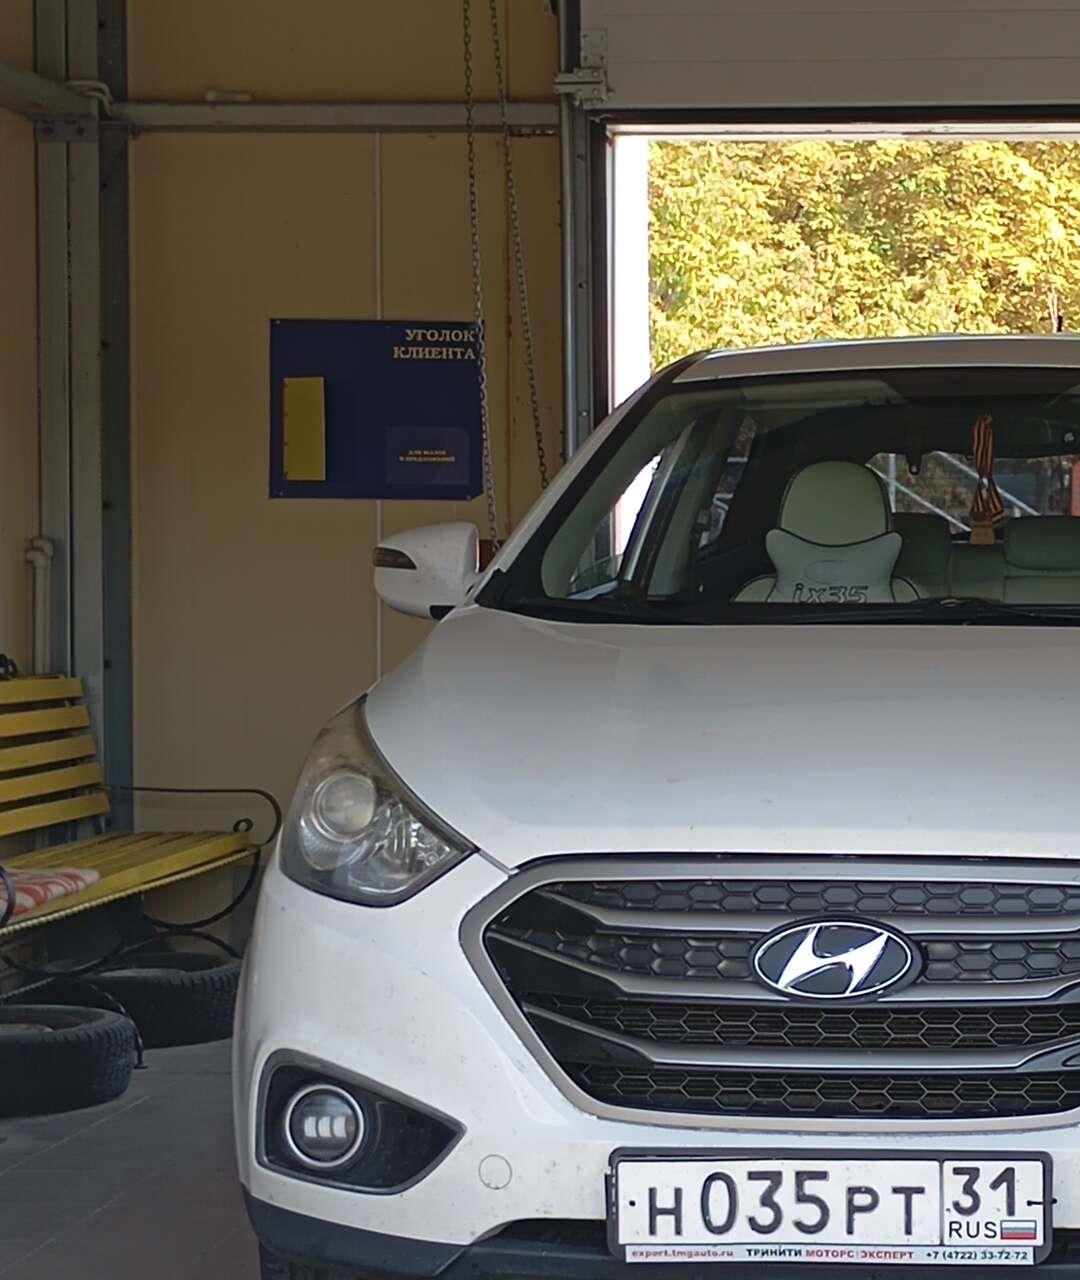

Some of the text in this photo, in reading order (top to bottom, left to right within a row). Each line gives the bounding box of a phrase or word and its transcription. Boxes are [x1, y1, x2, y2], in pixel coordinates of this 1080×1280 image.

[405, 329, 475, 342] УГОЛОК
[392, 346, 476, 360] КЛИЕНТА
[951, 1167, 1016, 1216] 31
[648, 1171, 925, 1236] Н035РТ
[948, 1221, 997, 1239] RUS
[747, 1248, 802, 1258] ТРИНИТИ
[805, 1249, 855, 1259] МОТОРС
